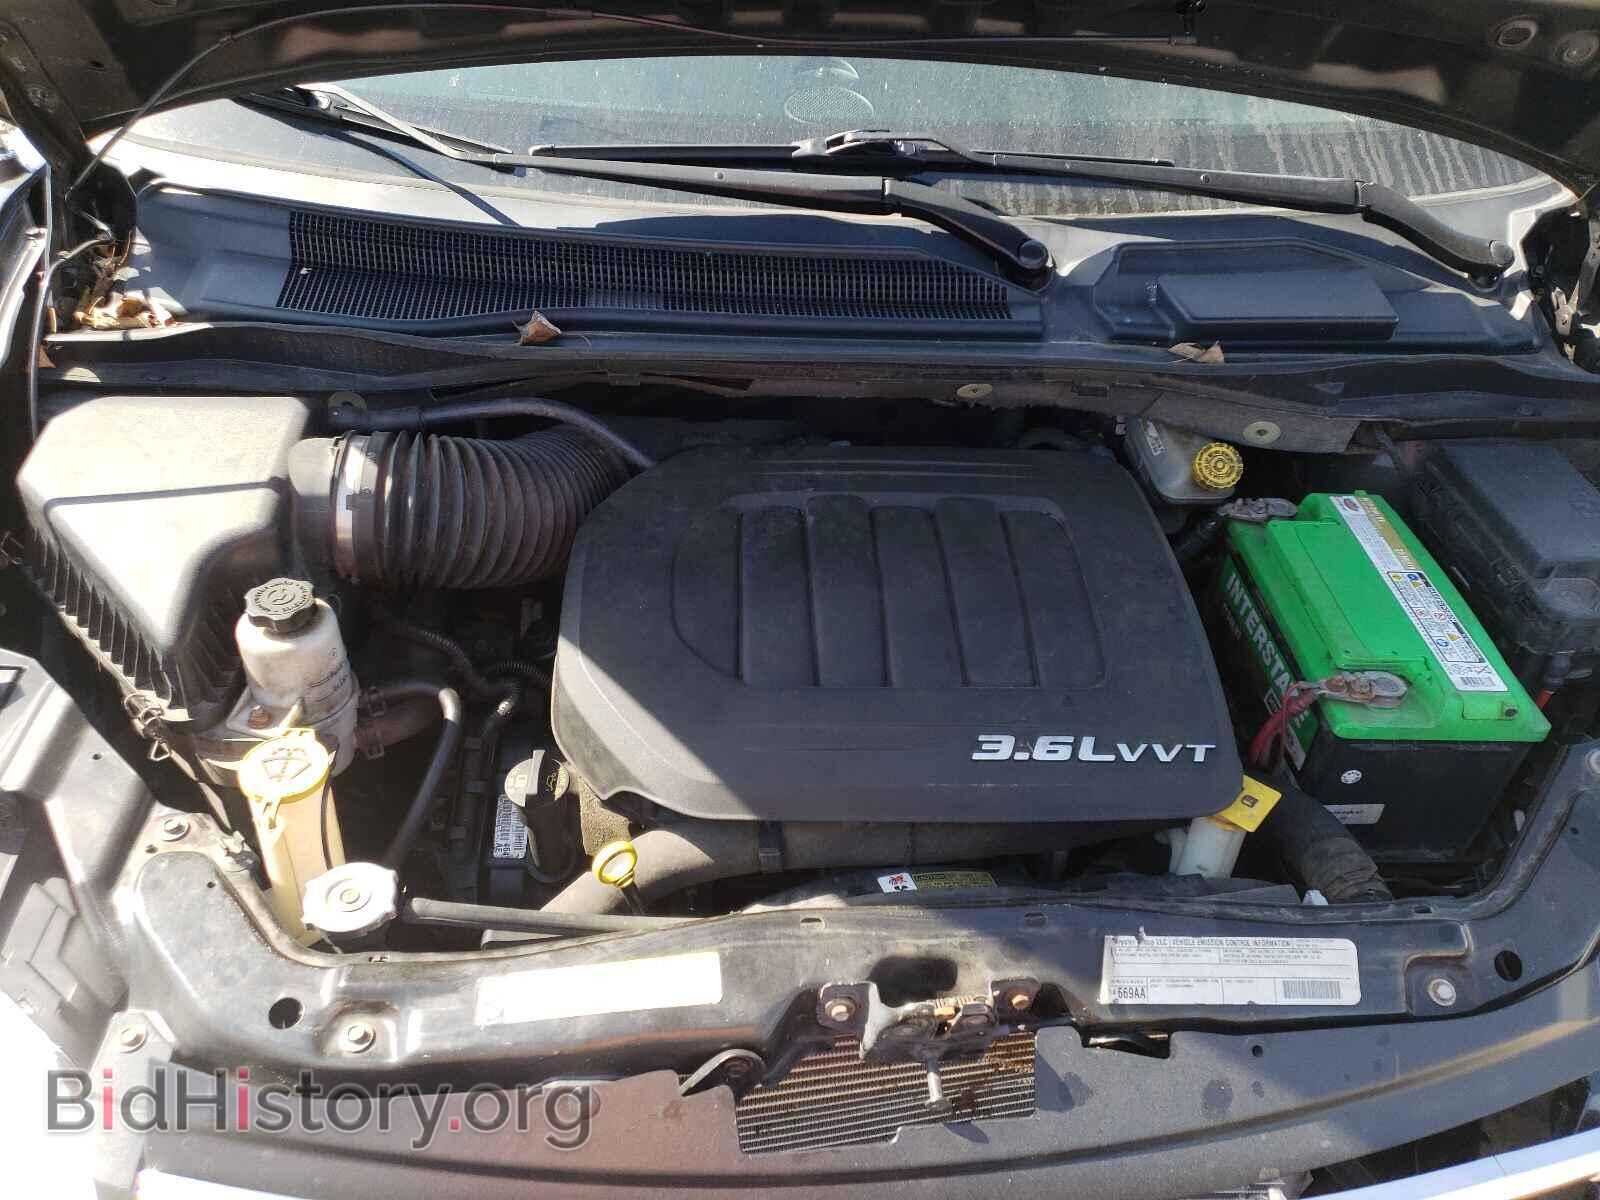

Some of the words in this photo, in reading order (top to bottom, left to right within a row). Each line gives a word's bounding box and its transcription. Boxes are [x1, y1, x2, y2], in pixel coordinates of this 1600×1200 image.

[1226, 572, 1309, 748] INTERSTA
[972, 734, 1116, 762] 3.6L
[1116, 743, 1217, 762] VVT
